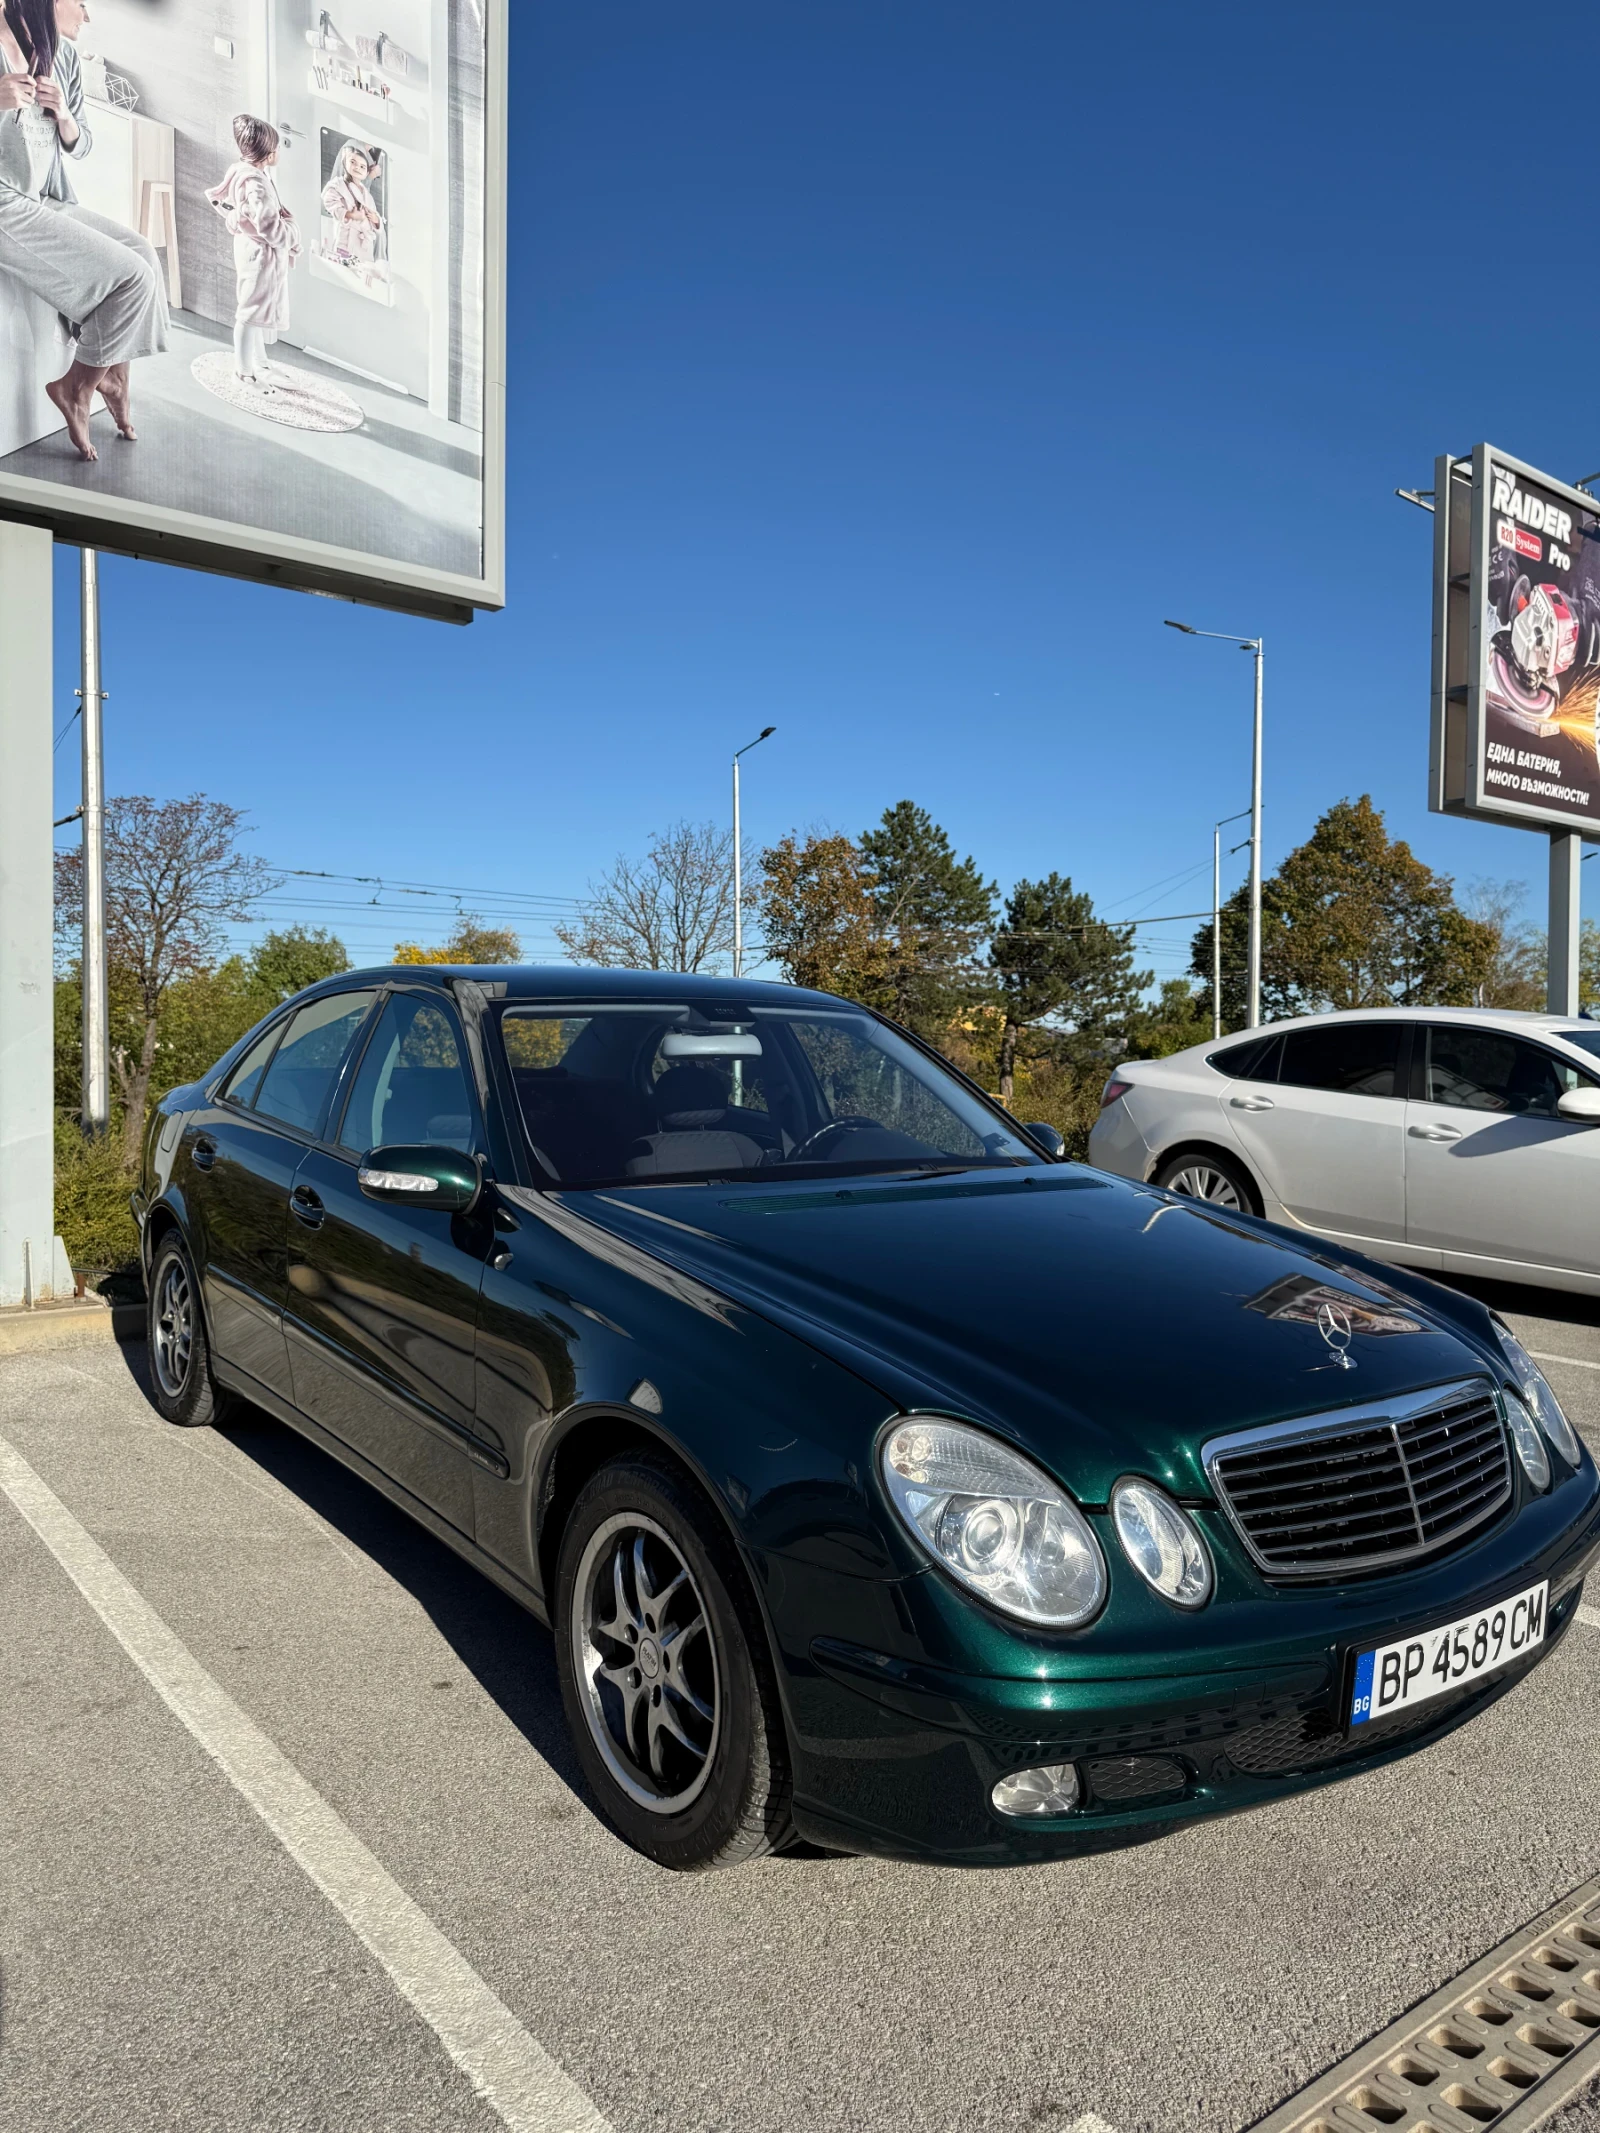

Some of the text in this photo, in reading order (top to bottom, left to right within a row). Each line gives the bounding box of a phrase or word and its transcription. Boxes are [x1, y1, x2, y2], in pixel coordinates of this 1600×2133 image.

[1492, 478, 1571, 545] RAIDER
[1501, 525, 1540, 555] R20 System
[1548, 542, 1571, 571] Pro
[1486, 742, 1561, 778] ЕДНА БАТЕРИЯ,
[1486, 768, 1590, 806] МНОГО ВЪЗМОЖНОСТИ!
[1378, 1588, 1544, 1708] BP 4589 CM
[1353, 1695, 1370, 1715] BG
